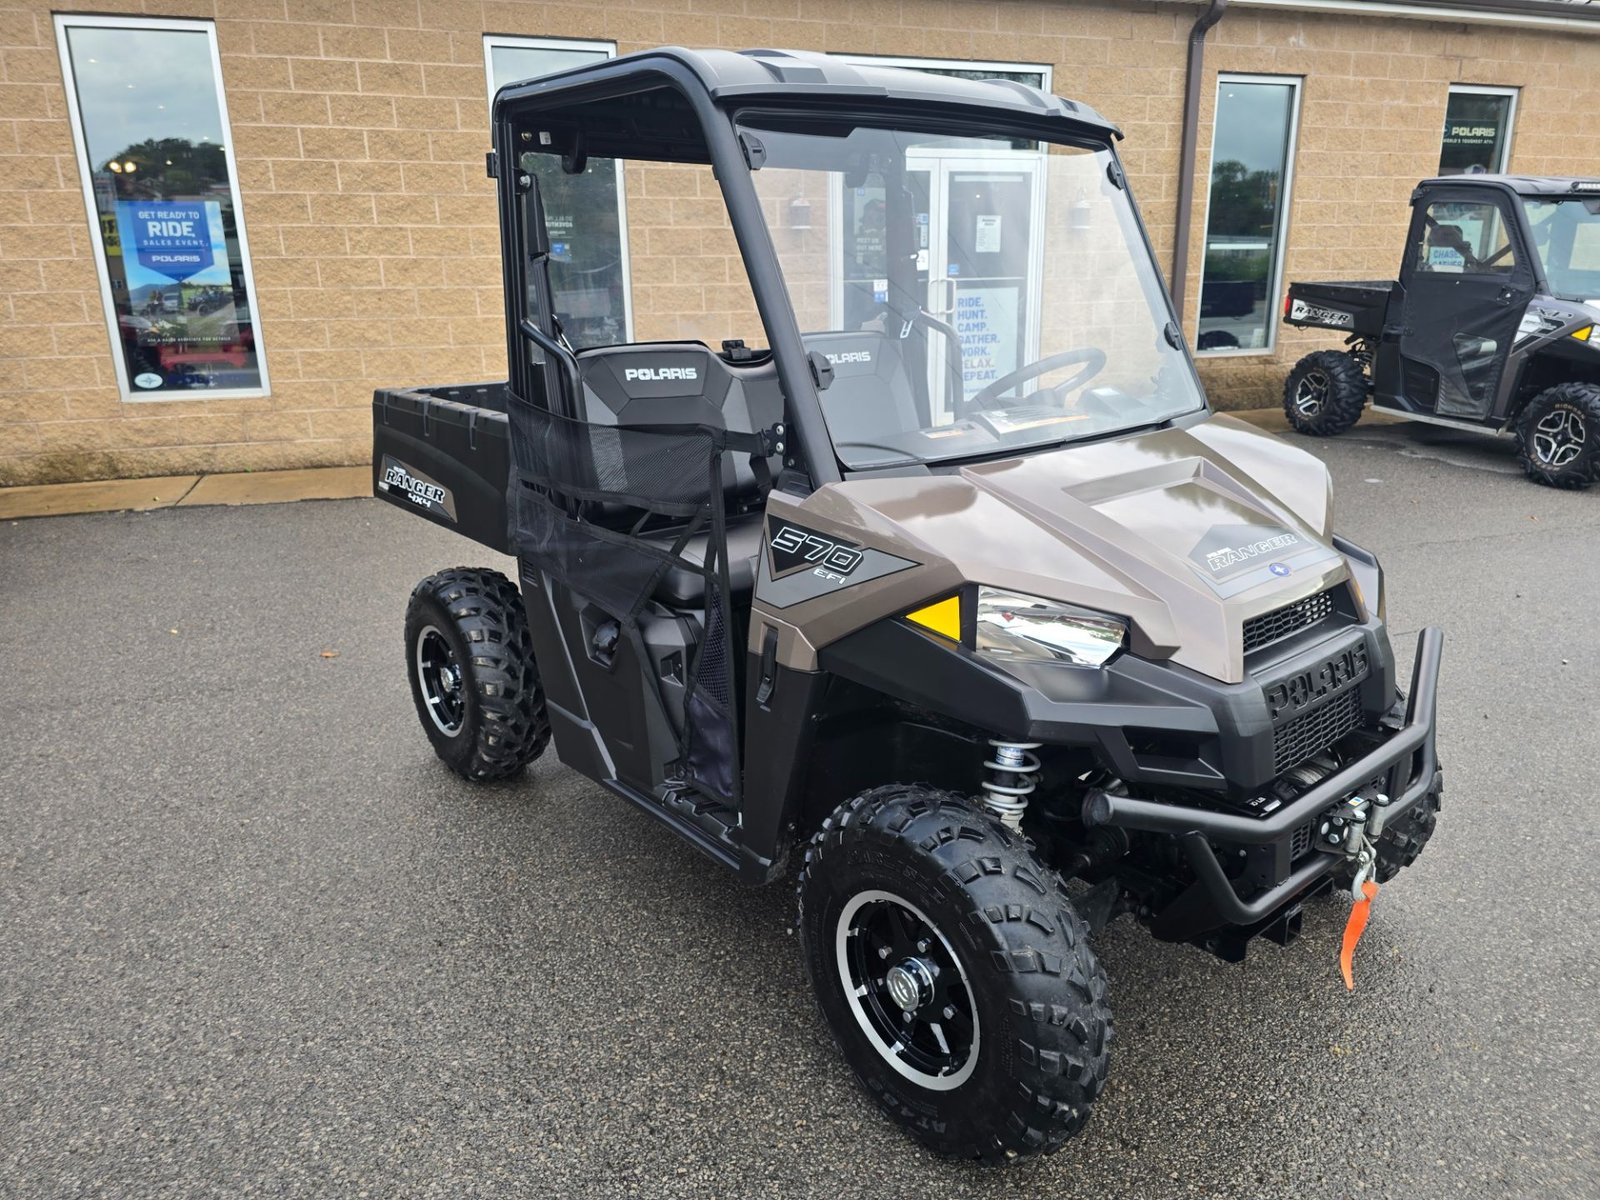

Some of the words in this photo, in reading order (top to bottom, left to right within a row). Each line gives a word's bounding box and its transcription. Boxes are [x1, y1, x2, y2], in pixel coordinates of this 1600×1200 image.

[1451, 127, 1496, 137] POLARIS
[138, 211, 155, 219] GET
[157, 211, 186, 219] READY
[188, 211, 199, 219] TO
[957, 297, 984, 308] RIDE.
[957, 309, 988, 320] HUNT.
[1294, 306, 1349, 321] RANGER
[957, 322, 990, 333] CAMP.
[826, 351, 871, 364] OLARIS
[963, 359, 995, 369] ELAX.
[625, 368, 698, 381] POLARIS
[963, 370, 999, 381] EPEAT.
[385, 468, 446, 504] RANGER
[771, 526, 864, 574] 570
[1207, 533, 1298, 572] RANGER
[813, 568, 846, 584] EFI
[1268, 643, 1369, 721] POLARIS
